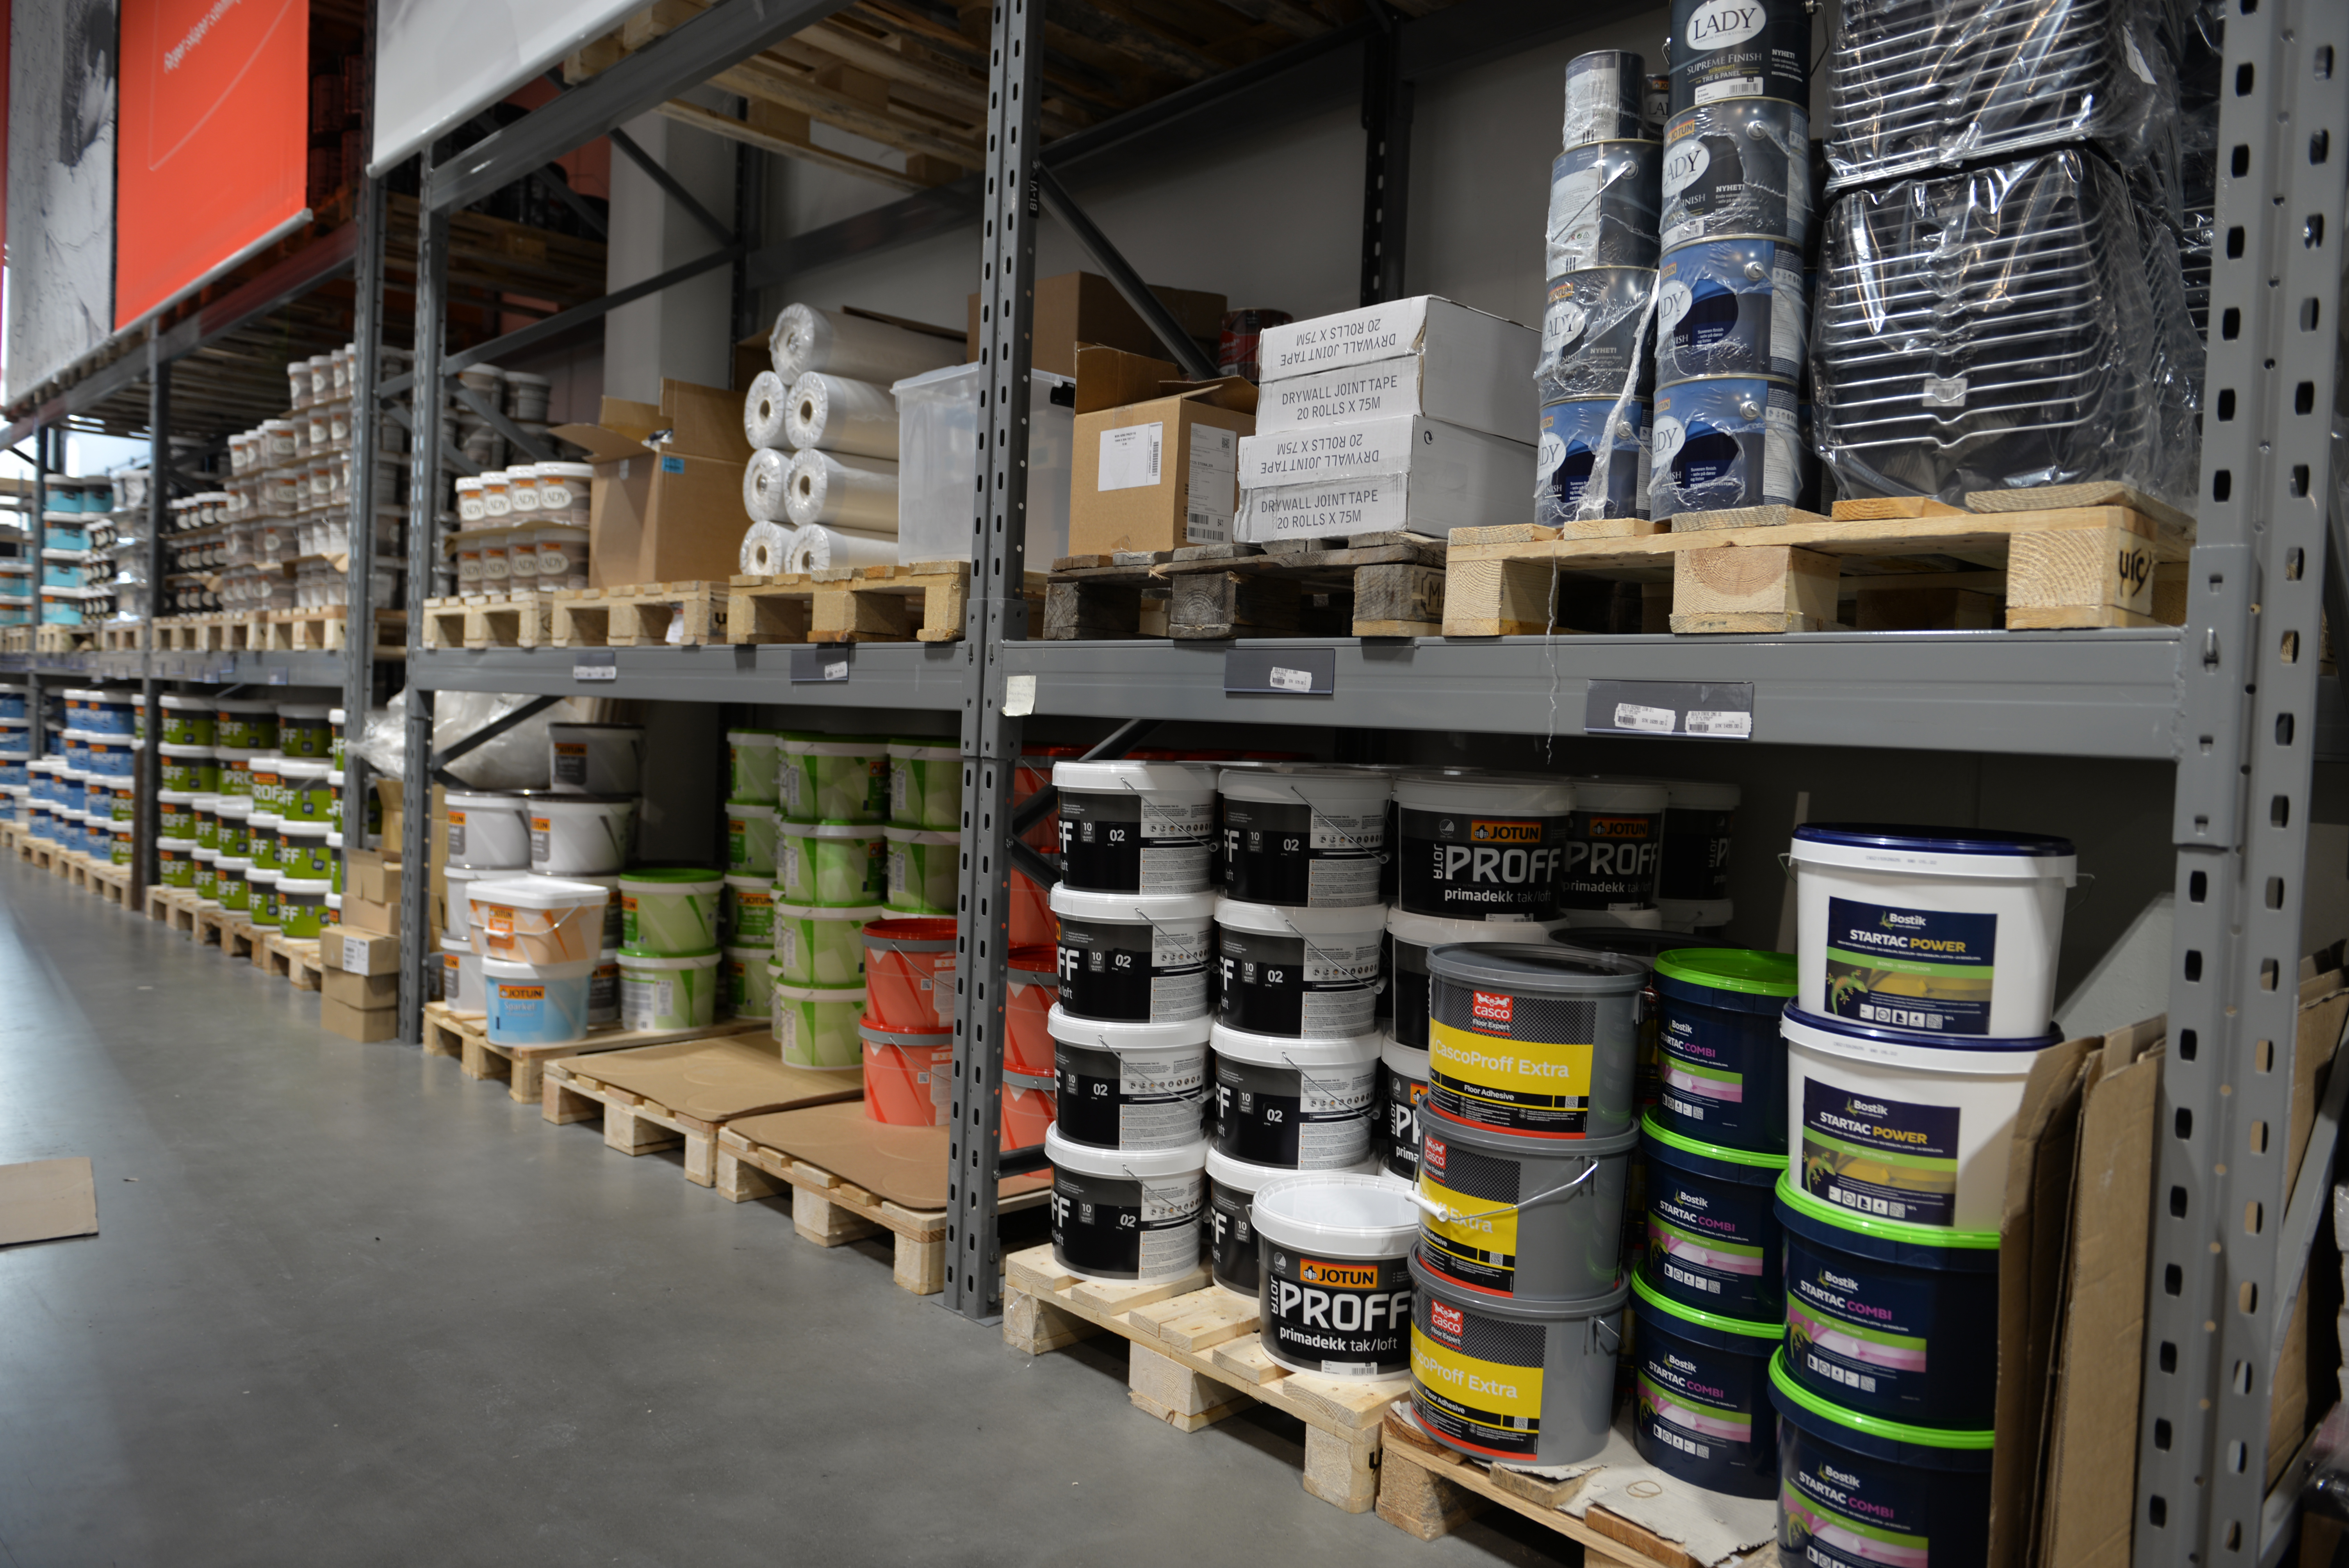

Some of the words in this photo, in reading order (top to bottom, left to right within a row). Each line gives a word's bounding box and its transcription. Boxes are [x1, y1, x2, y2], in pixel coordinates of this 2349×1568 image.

[1693, 8, 1757, 41] LADY
[1697, 35, 1715, 44] PREMIUM
[1772, 49, 1795, 59] NYHET!
[1687, 57, 1725, 75] SUPREME
[1728, 53, 1762, 63] FINISH
[1709, 64, 1735, 74] silkematt
[1702, 74, 1714, 83] TRE
[1720, 70, 1741, 78] PANEL
[1670, 123, 1693, 141] JOTUN
[1716, 184, 1745, 192] NYHET!
[1330, 322, 1364, 339] ROLLS
[1368, 319, 1381, 332] 20
[1296, 332, 1316, 346] 75M
[1320, 329, 1327, 341] X
[1344, 333, 1396, 355] DRYWALL
[1280, 351, 1306, 366] TAPE
[1308, 344, 1339, 361] JOINT
[1282, 386, 1331, 405] DRYWALL
[1335, 380, 1366, 397] JOINT
[1369, 375, 1397, 390] TAPE
[1297, 408, 1308, 420] 20
[1312, 402, 1344, 418] ROLLS
[1349, 400, 1355, 412] X
[1359, 397, 1380, 411] 75M
[1301, 441, 1309, 452] X
[1312, 436, 1346, 451] ROLLS
[1350, 434, 1363, 447] 20
[1277, 442, 1297, 455] 75M
[1290, 456, 1321, 471] JOINT
[1325, 450, 1379, 467] DRYWALL
[1260, 460, 1287, 474] TAPE
[1262, 497, 1311, 513] DRYWALL
[1315, 493, 1346, 508] JOINT
[1349, 490, 1378, 503] TAPE
[1277, 517, 1289, 529] 20
[1292, 513, 1325, 527] ROLLS
[1329, 512, 1335, 524] X
[1340, 510, 1361, 523] 75M
[1083, 822, 1092, 831] 10
[1490, 827, 1539, 839] JOTUN
[1607, 823, 1646, 835] JOTUN
[1110, 829, 1125, 841] 02
[1250, 832, 1260, 841] 10
[1283, 839, 1299, 851] 02
[1433, 844, 1444, 879] JOTA
[1446, 845, 1561, 883] PROFF
[1565, 841, 1658, 875] PROFF
[1563, 880, 1625, 893] primadekk
[1445, 888, 1514, 902] primadekk
[1517, 890, 1551, 903] tak/loft
[1889, 913, 1927, 926] Bostik
[1850, 929, 1908, 948] STARTAC
[1910, 938, 1966, 952] POWER
[1058, 946, 1079, 981] FF
[1092, 952, 1101, 961] 10
[1115, 954, 1132, 968] 02
[1244, 962, 1254, 972] 10
[1268, 970, 1283, 983] 02
[508, 988, 543, 997] JOTUN
[1473, 1019, 1487, 1027] Floor
[1488, 1021, 1510, 1032] Expert
[1672, 1019, 1692, 1033] Bostik
[1661, 1031, 1684, 1050] STARTAC
[1684, 1043, 1716, 1058] COMBI
[1436, 1039, 1514, 1073] CascoProff
[1518, 1059, 1569, 1078] Extra
[1068, 1074, 1076, 1083] 10
[1093, 1083, 1108, 1096] 02
[1241, 1092, 1251, 1102] 10
[1464, 1084, 1480, 1094] Floor
[1481, 1088, 1515, 1101] Adhesive
[1854, 1099, 1888, 1115] Bostik
[1267, 1108, 1283, 1123] 02
[1820, 1111, 1871, 1135] STARTAC
[1873, 1126, 1928, 1145] POWER
[1431, 1166, 1445, 1178] Expert
[1681, 1191, 1708, 1208] Bostik
[1082, 1203, 1091, 1213] 10
[1120, 1213, 1136, 1228] 02
[1450, 1207, 1493, 1233] Extra
[1660, 1200, 1697, 1223] STARTAC
[1698, 1216, 1736, 1232] COMBI
[1238, 1220, 1247, 1230] 10
[1428, 1231, 1448, 1247] Adhesive
[1319, 1268, 1374, 1285] JOTUN
[1825, 1270, 1859, 1291] Bostik
[1271, 1275, 1279, 1315] JOTA
[1800, 1279, 1846, 1308] STARTAC
[1847, 1301, 1892, 1320] COMBI
[1280, 1279, 1412, 1332] PROFF
[1280, 1326, 1346, 1351] primadekk
[1349, 1337, 1397, 1352] tak/loft
[1431, 1326, 1443, 1337] Floor
[1443, 1332, 1461, 1345] Expert
[1669, 1354, 1697, 1373] Bostik
[1469, 1374, 1518, 1398] Extra
[1649, 1360, 1686, 1387] STARTAC
[1686, 1380, 1724, 1399] COMBI
[1425, 1388, 1437, 1401] Floor
[1437, 1398, 1465, 1414] Adhesive
[1825, 1465, 1861, 1488] Bostik
[1799, 1470, 1847, 1504] STARTAC
[1848, 1497, 1894, 1519] COMBI
